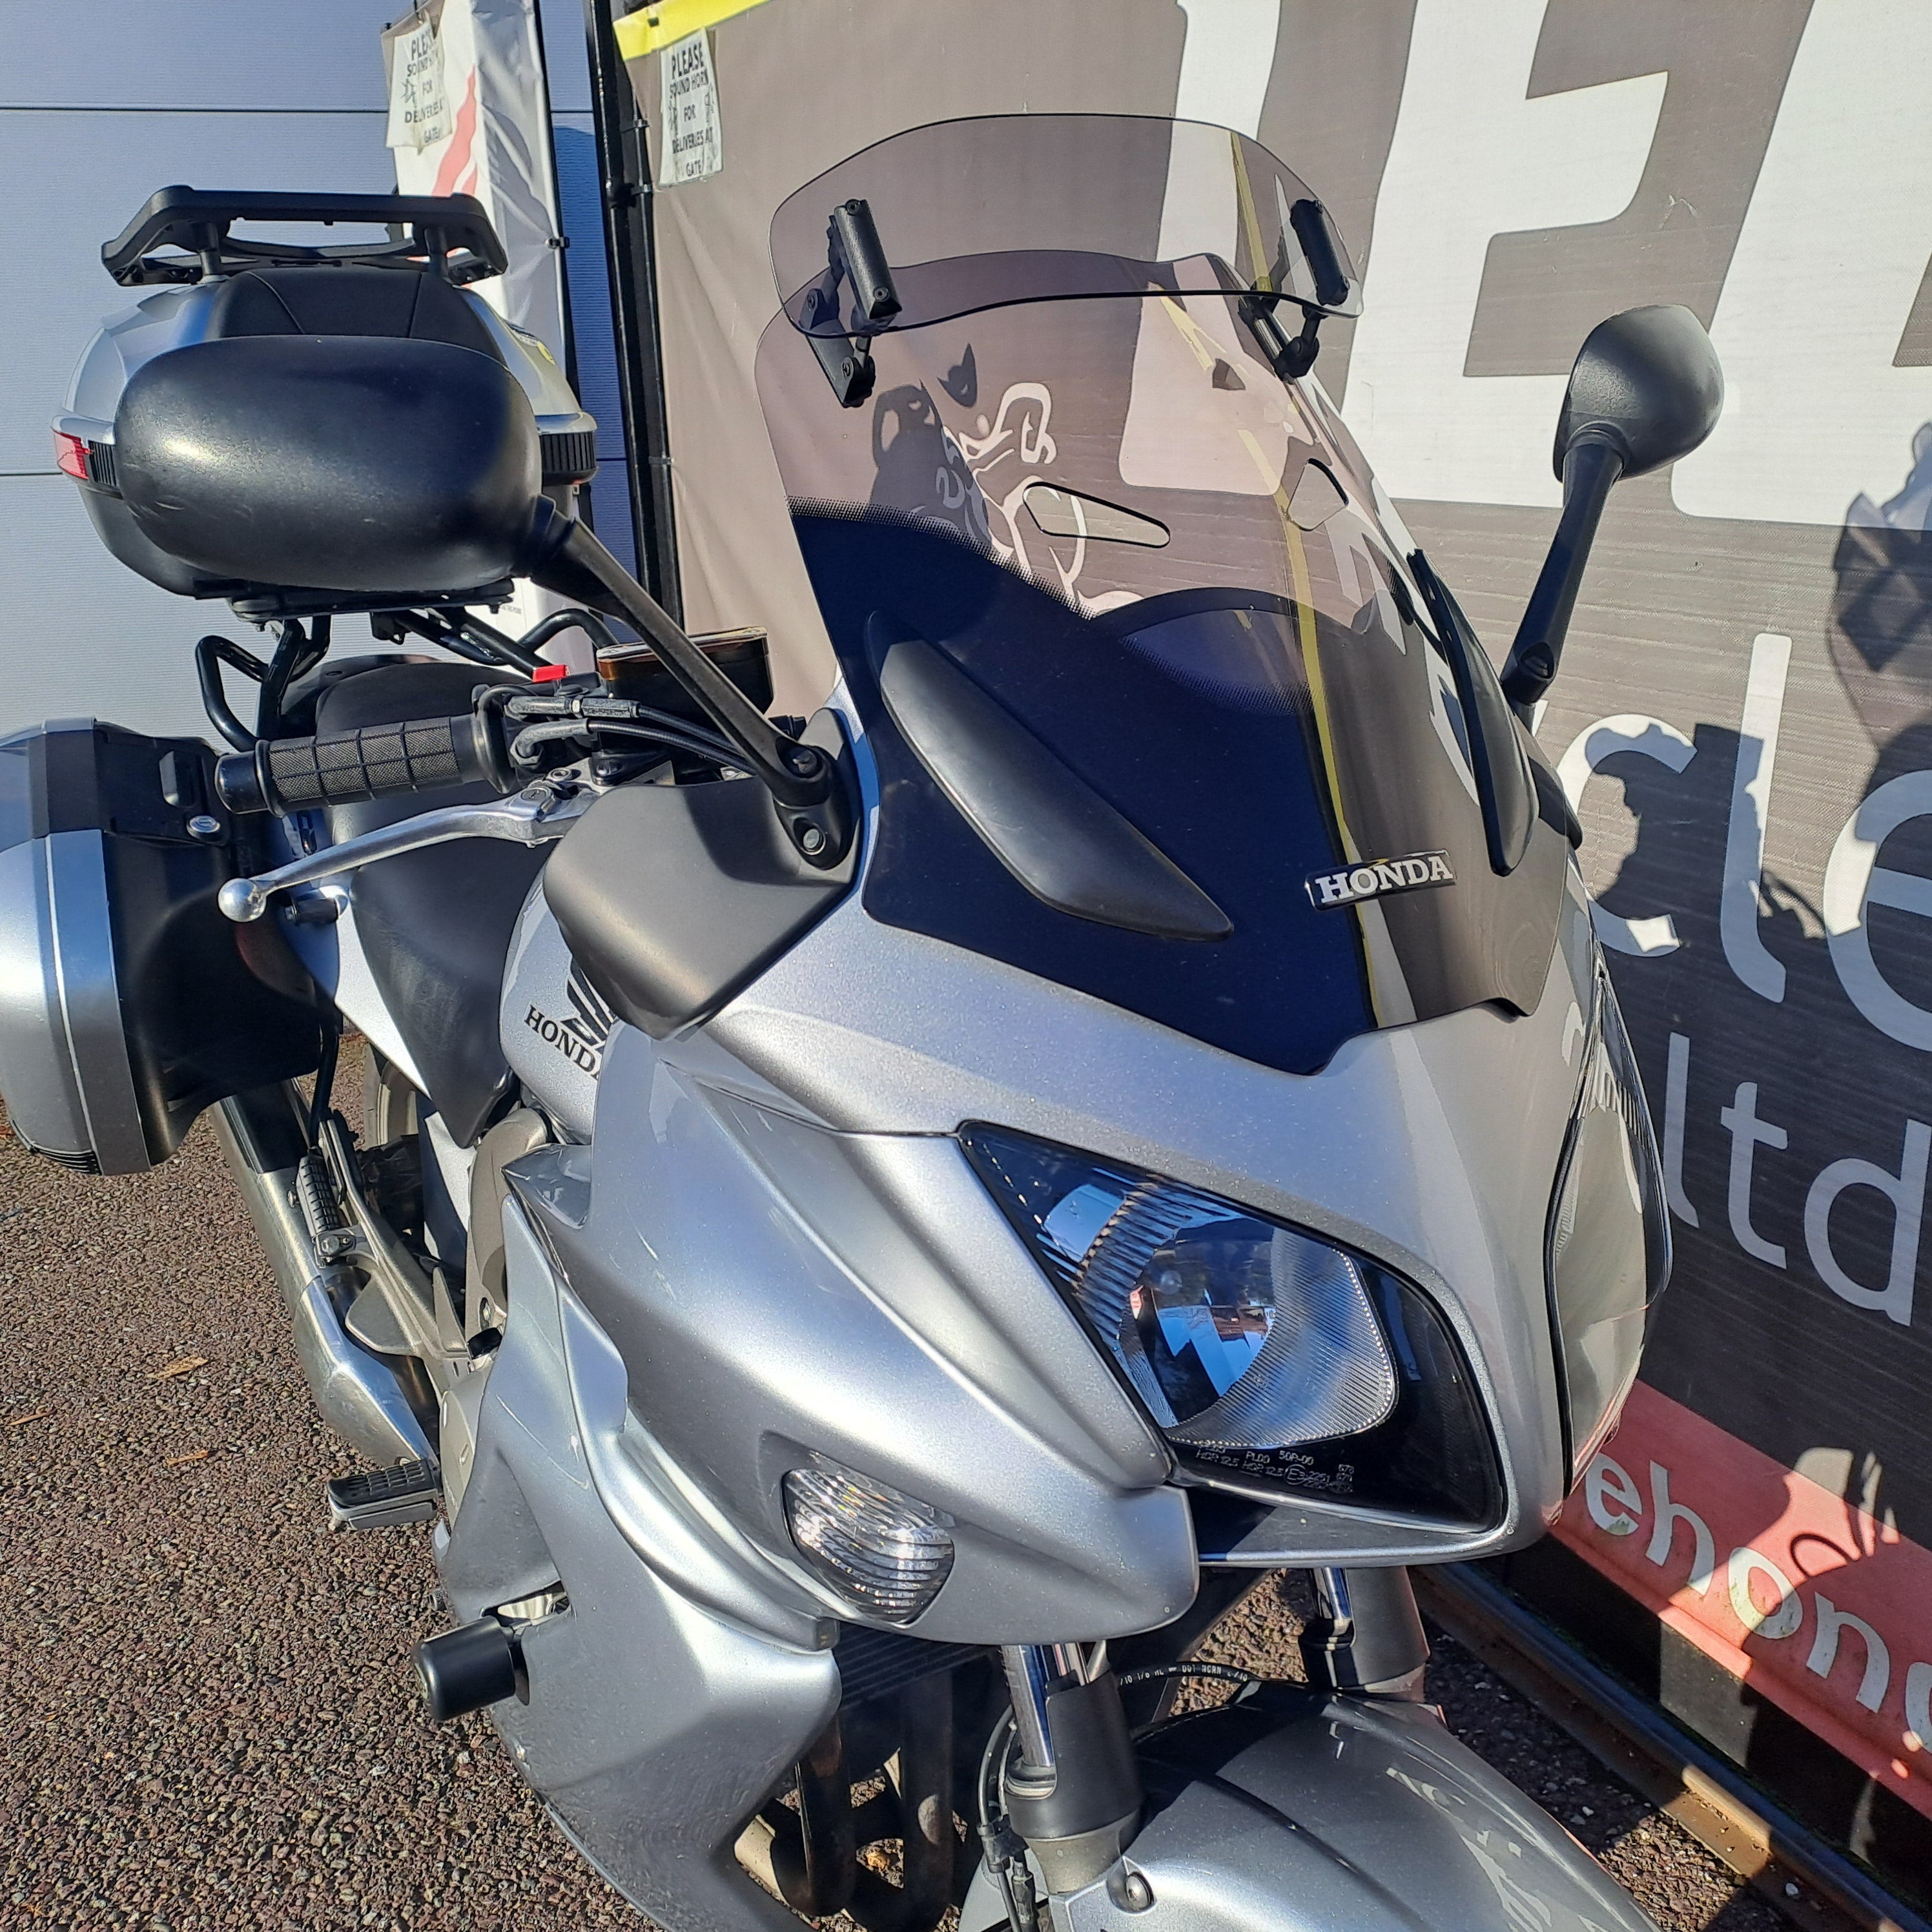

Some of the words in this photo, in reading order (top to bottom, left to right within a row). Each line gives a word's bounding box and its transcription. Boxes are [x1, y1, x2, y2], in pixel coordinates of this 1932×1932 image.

[672, 41, 704, 80] PLEASE
[670, 77, 690, 99] SOUND
[683, 103, 696, 123] FOR
[705, 126, 714, 143] AT
[686, 159, 703, 177] GATE
[1532, 633, 1932, 1053] cle
[1315, 856, 1454, 904] HONDA
[1663, 1033, 1932, 1328] ltd
